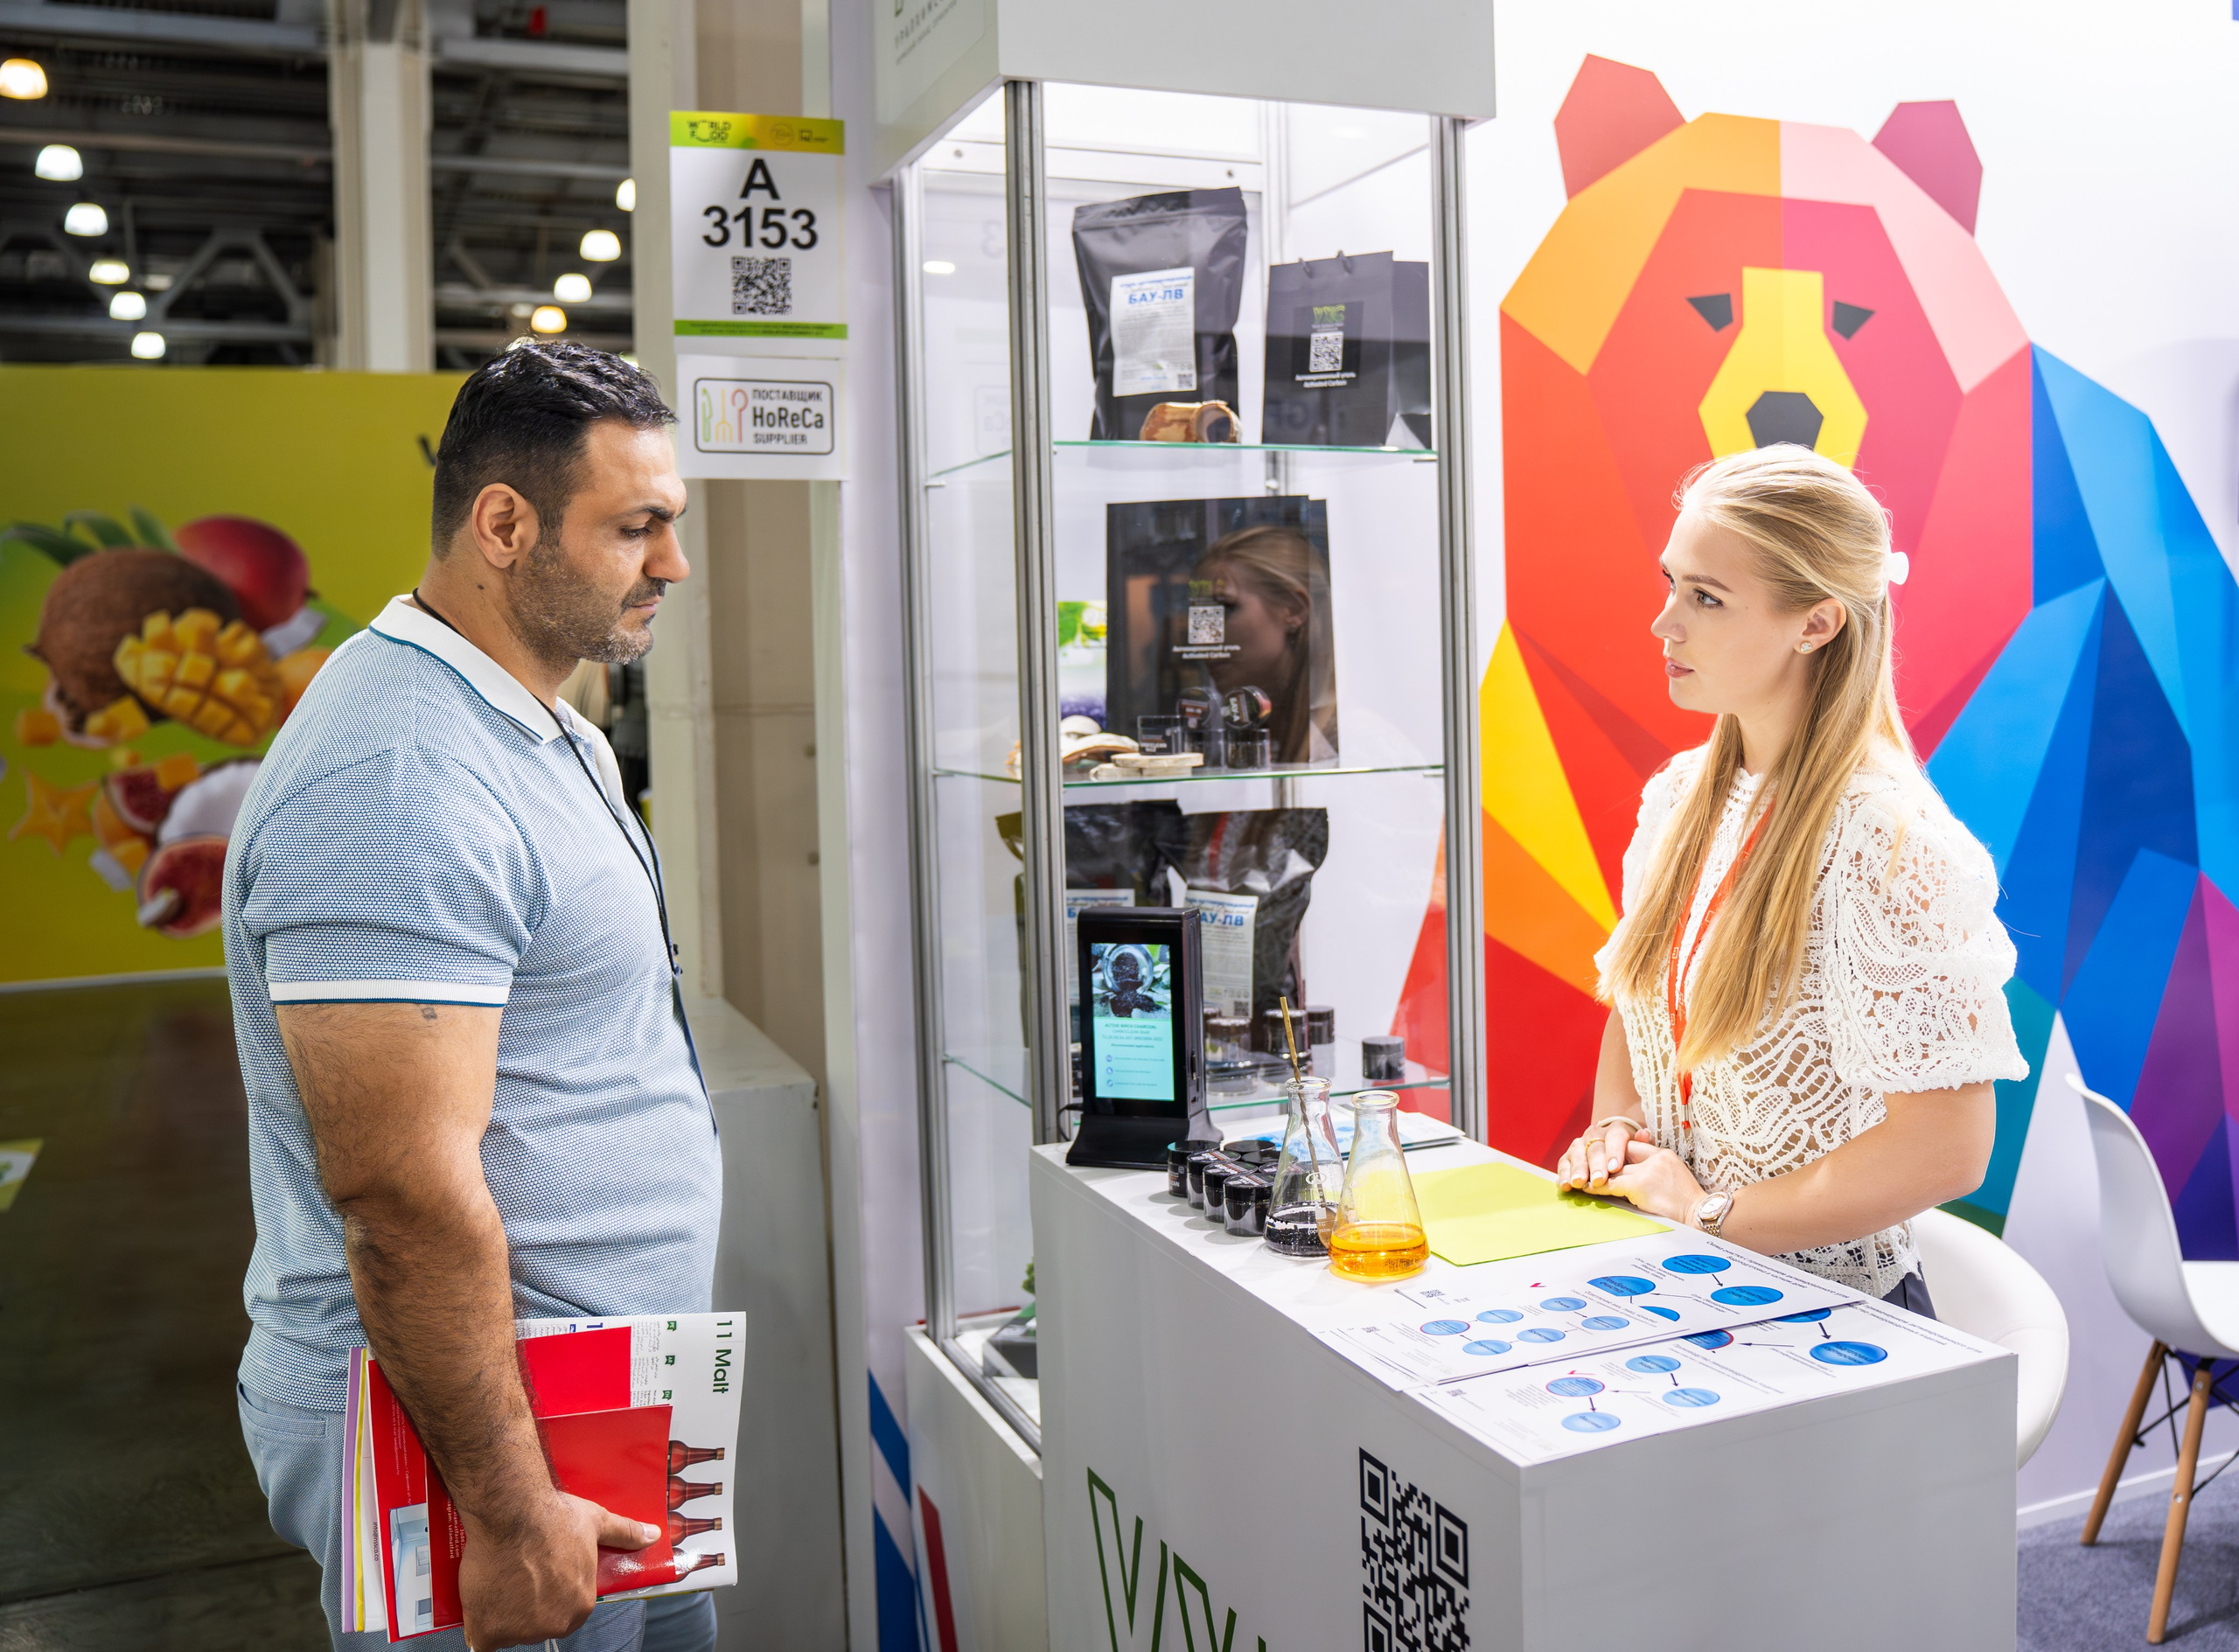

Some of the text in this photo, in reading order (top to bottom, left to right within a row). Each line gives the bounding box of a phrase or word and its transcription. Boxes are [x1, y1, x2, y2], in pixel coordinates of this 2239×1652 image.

[740, 158, 780, 200] A
[701, 206, 819, 250] 3153
[1128, 289, 1184, 305] БАУ-ЛВ
[752, 389, 823, 403] ПОСТАВЩИК
[752, 406, 825, 429] HoReCa
[752, 433, 808, 445] SUPPLIER
[1200, 911, 1245, 927] АУ-ЛВ
[712, 1349, 732, 1394] Malt
